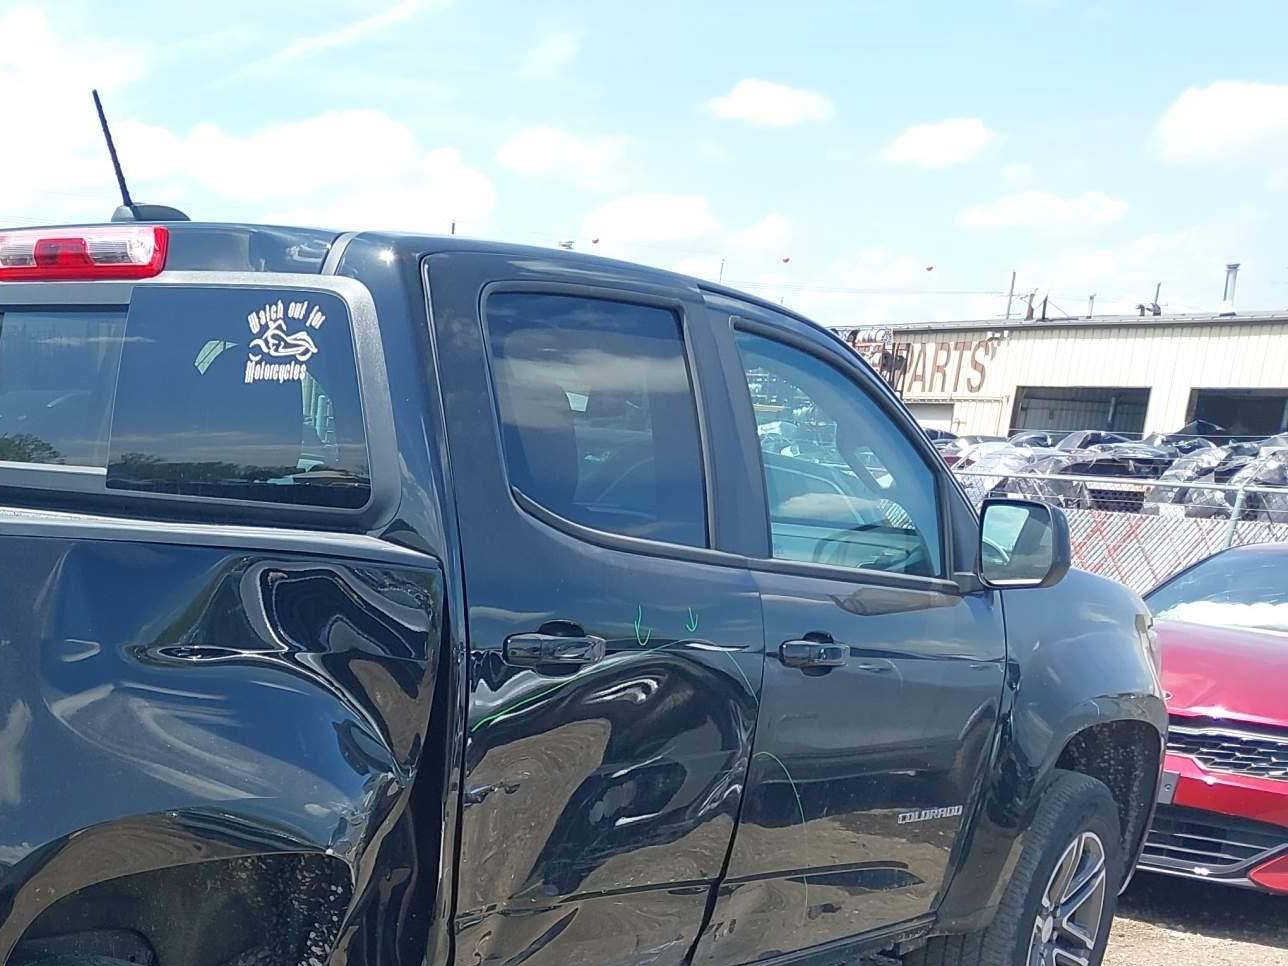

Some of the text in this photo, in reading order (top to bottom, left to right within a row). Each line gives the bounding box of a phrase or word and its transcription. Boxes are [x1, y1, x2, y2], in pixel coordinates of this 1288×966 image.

[248, 300, 326, 334] Watch out for
[244, 360, 307, 384] Motorcycles
[897, 805, 964, 824] COLORADO
